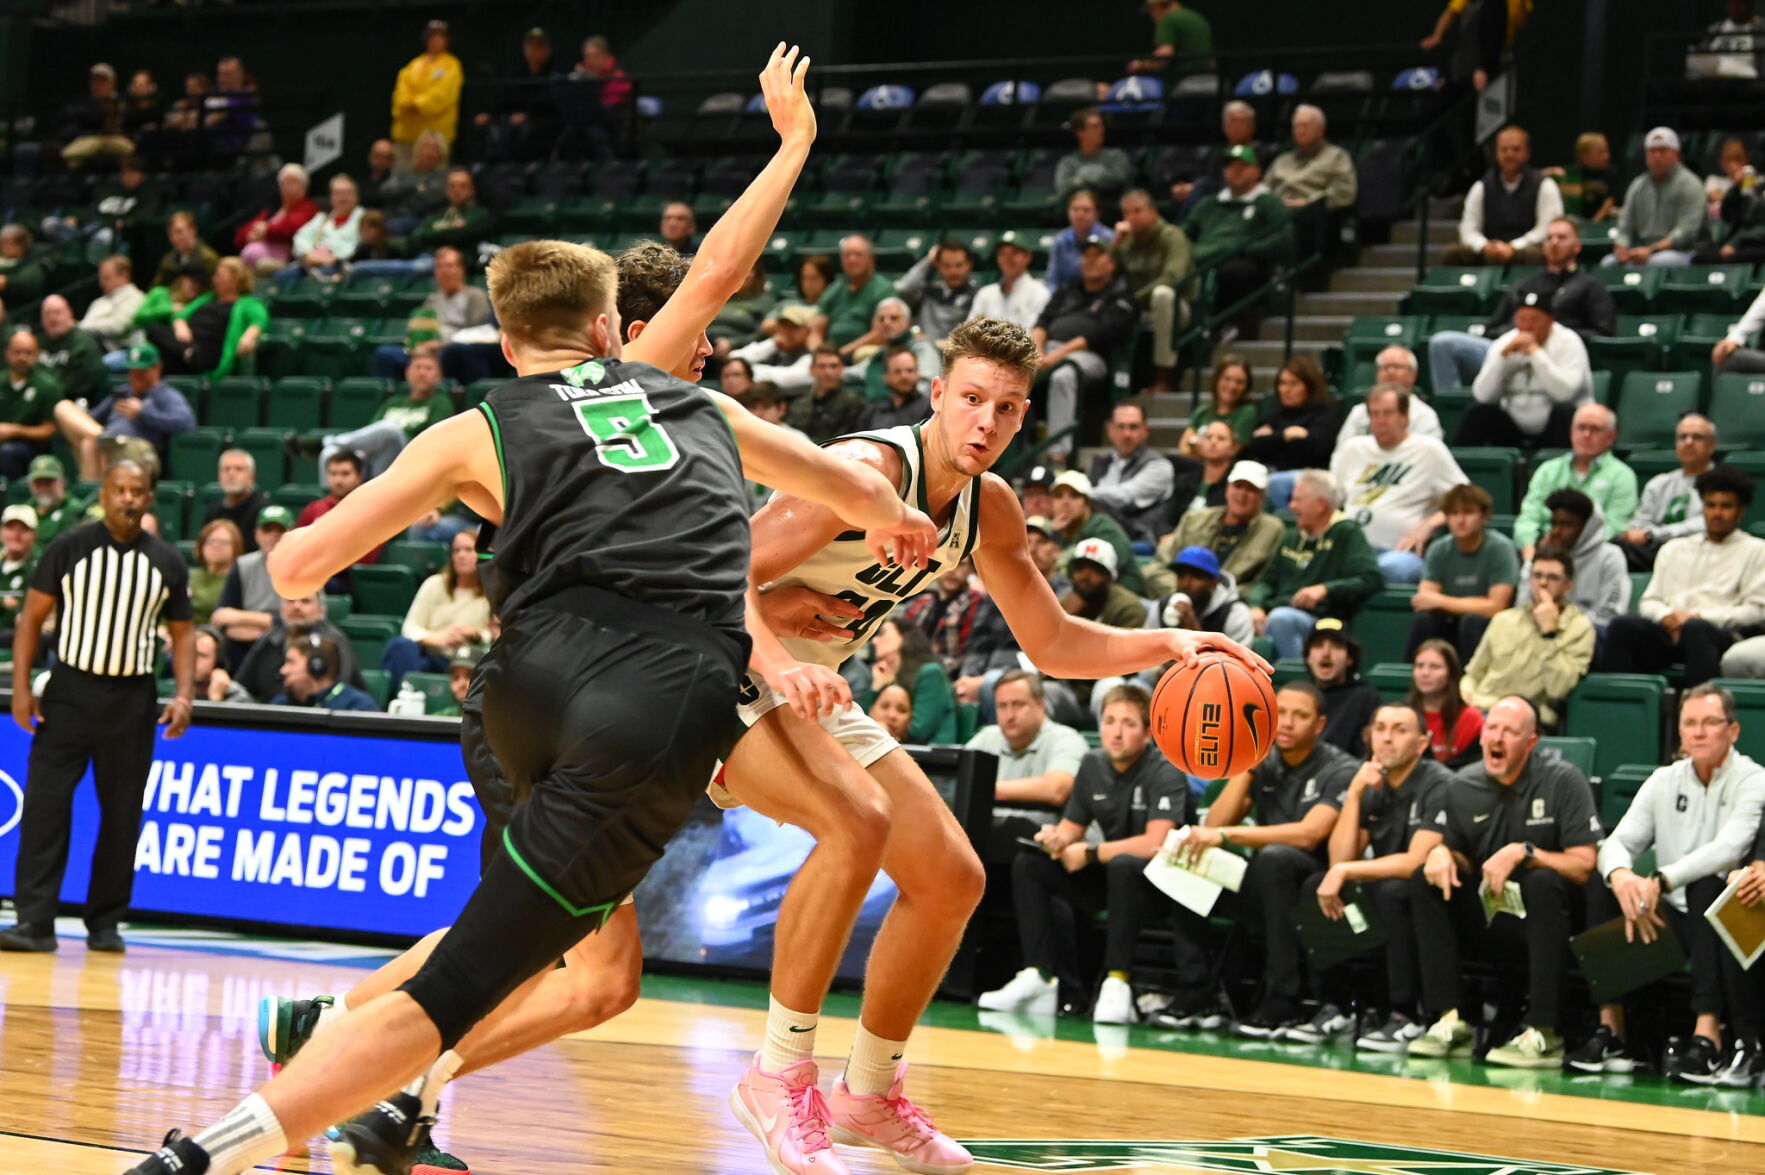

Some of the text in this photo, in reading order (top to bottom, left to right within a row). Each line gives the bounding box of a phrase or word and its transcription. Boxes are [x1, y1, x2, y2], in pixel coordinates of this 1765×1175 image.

[571, 393, 681, 474] 5
[854, 554, 943, 598] CLT
[1200, 703, 1222, 767] ELITE
[259, 768, 476, 837] LEGENDS
[134, 820, 448, 898] ARE MADE OF
